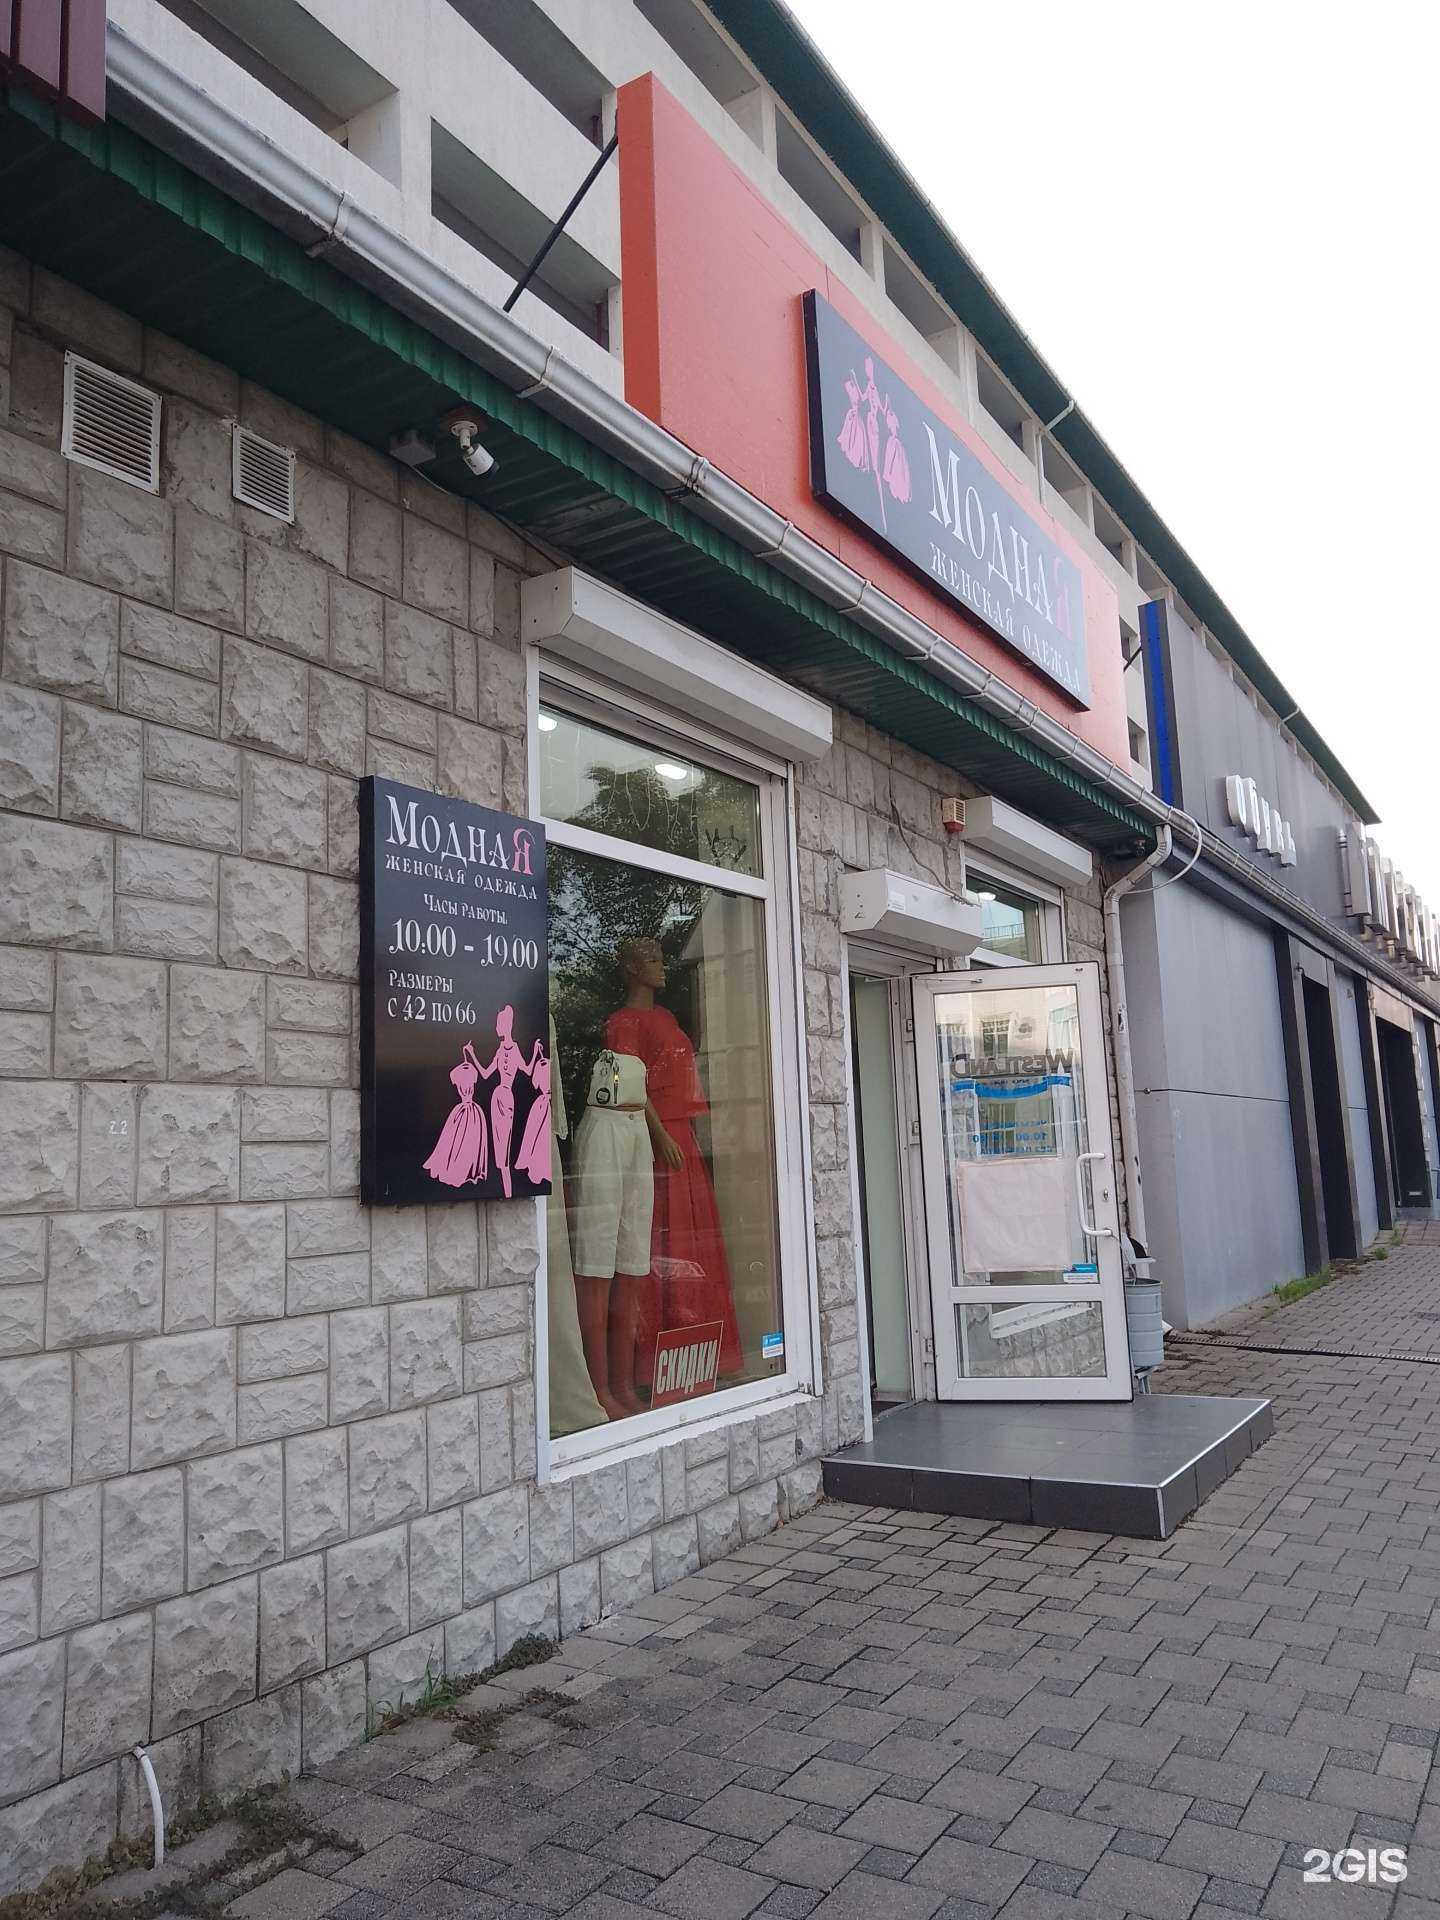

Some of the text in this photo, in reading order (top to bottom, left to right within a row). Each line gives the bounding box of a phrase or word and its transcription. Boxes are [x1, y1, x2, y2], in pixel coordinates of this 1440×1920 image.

[930, 542, 1015, 637] ЖЕНСКАЯ
[385, 854, 538, 900] ЖЕНСКАЯ ОДЕЖДА
[423, 893, 458, 916] ЧАСЫ
[388, 918, 457, 958] 10:00
[480, 933, 539, 970] 19.00
[389, 969, 453, 994] РАЗМЕРЫ
[402, 994, 426, 1021] 42
[431, 1002, 452, 1023] ПО
[455, 1000, 477, 1025] 66
[656, 1339, 718, 1395] СКИДКИ
